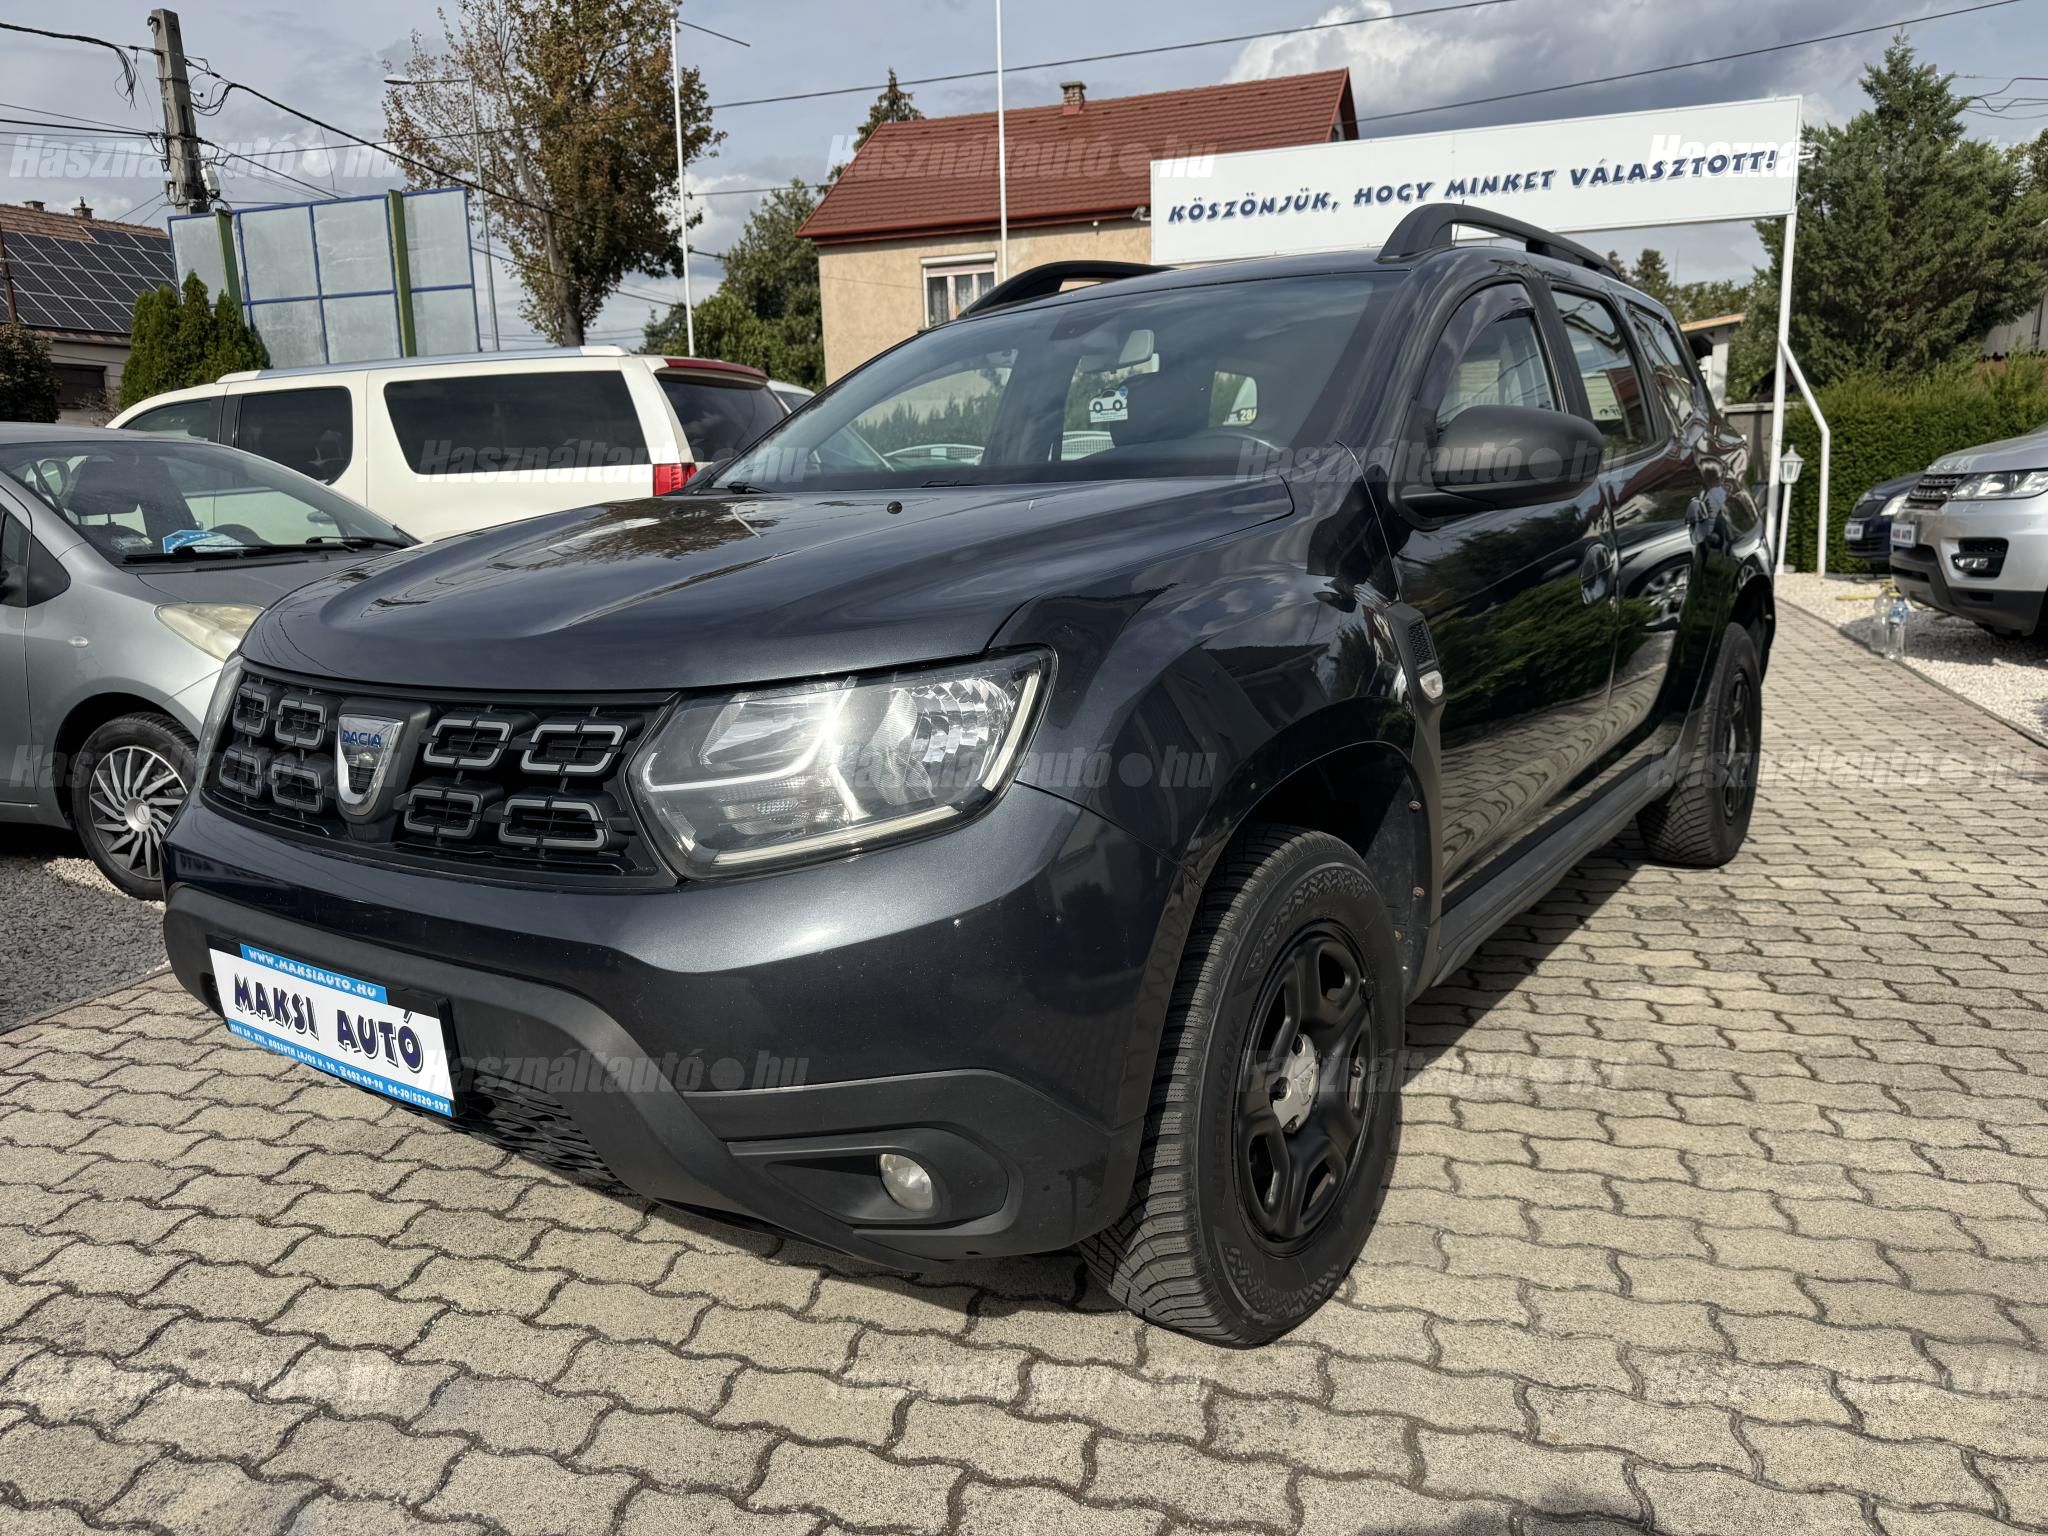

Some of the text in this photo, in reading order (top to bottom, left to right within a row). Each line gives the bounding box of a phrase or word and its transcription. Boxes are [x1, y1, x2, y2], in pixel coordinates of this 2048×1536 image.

[1168, 149, 1778, 224] KÖSZÖNJÜK, HOGY MINKET VÁLASZTOTT!
[342, 730, 381, 748] DACIA
[248, 949, 376, 999] WWW.MAKSIAUTO.HU
[234, 973, 424, 1074] MAKSI AUTÓ
